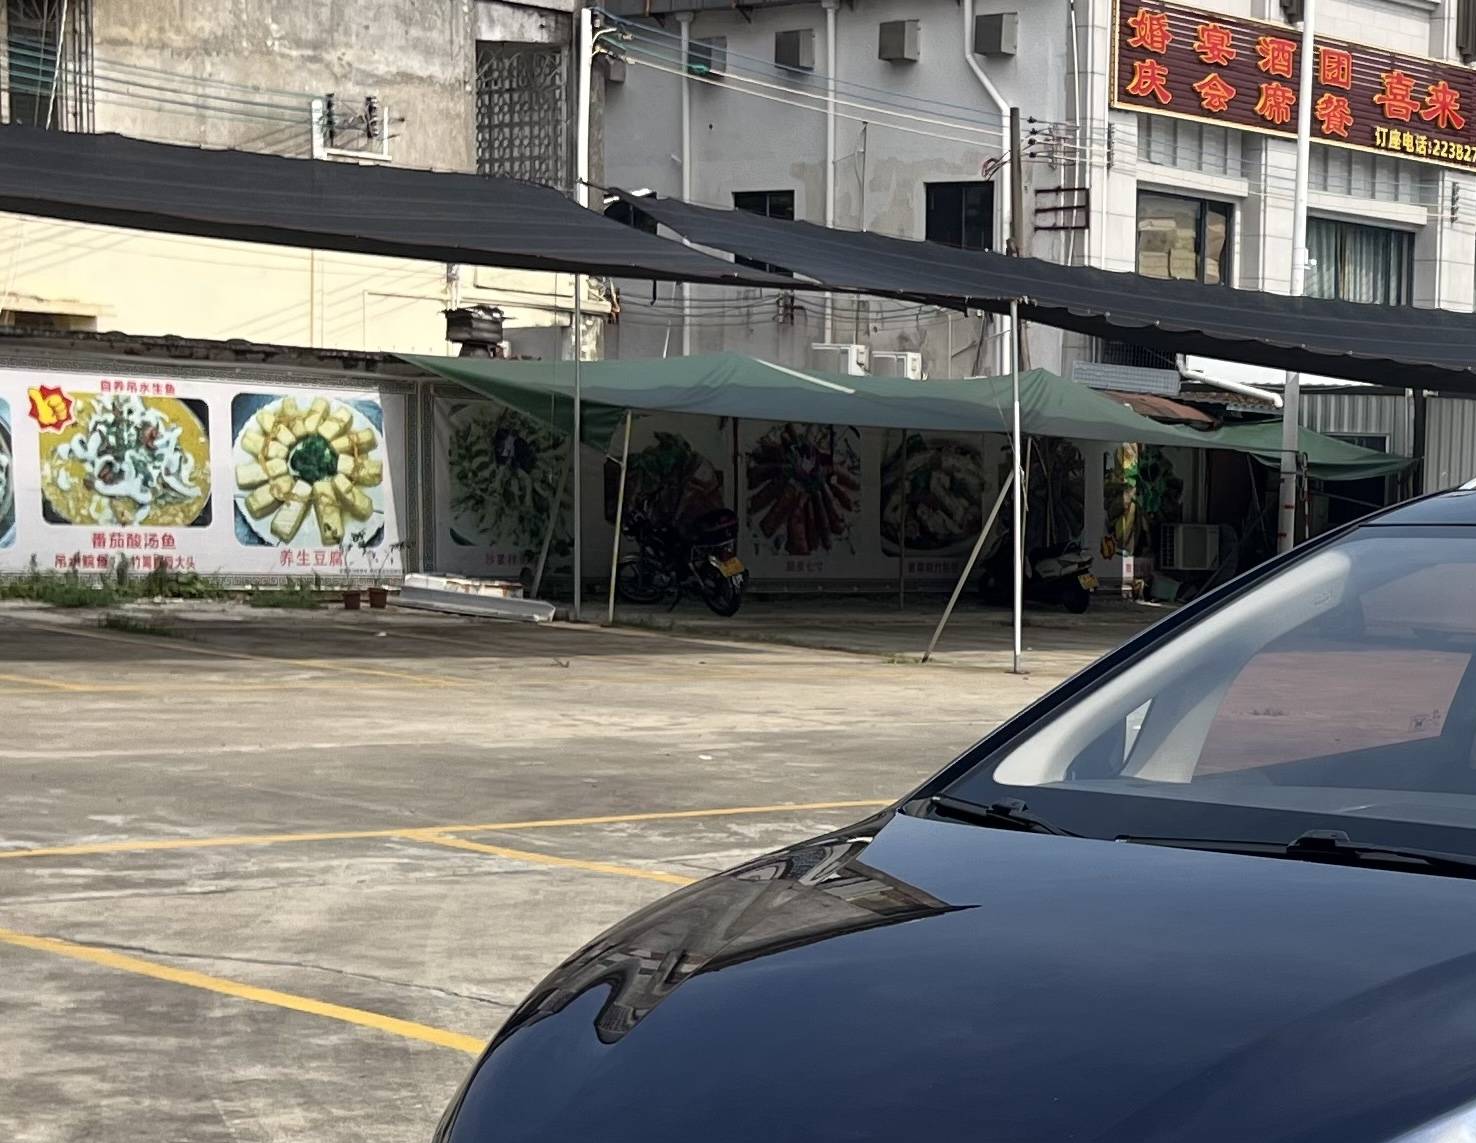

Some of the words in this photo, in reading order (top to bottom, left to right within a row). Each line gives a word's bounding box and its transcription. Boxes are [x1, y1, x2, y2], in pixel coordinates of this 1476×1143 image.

[91, 532, 177, 550] 番茄酸汤鱼
